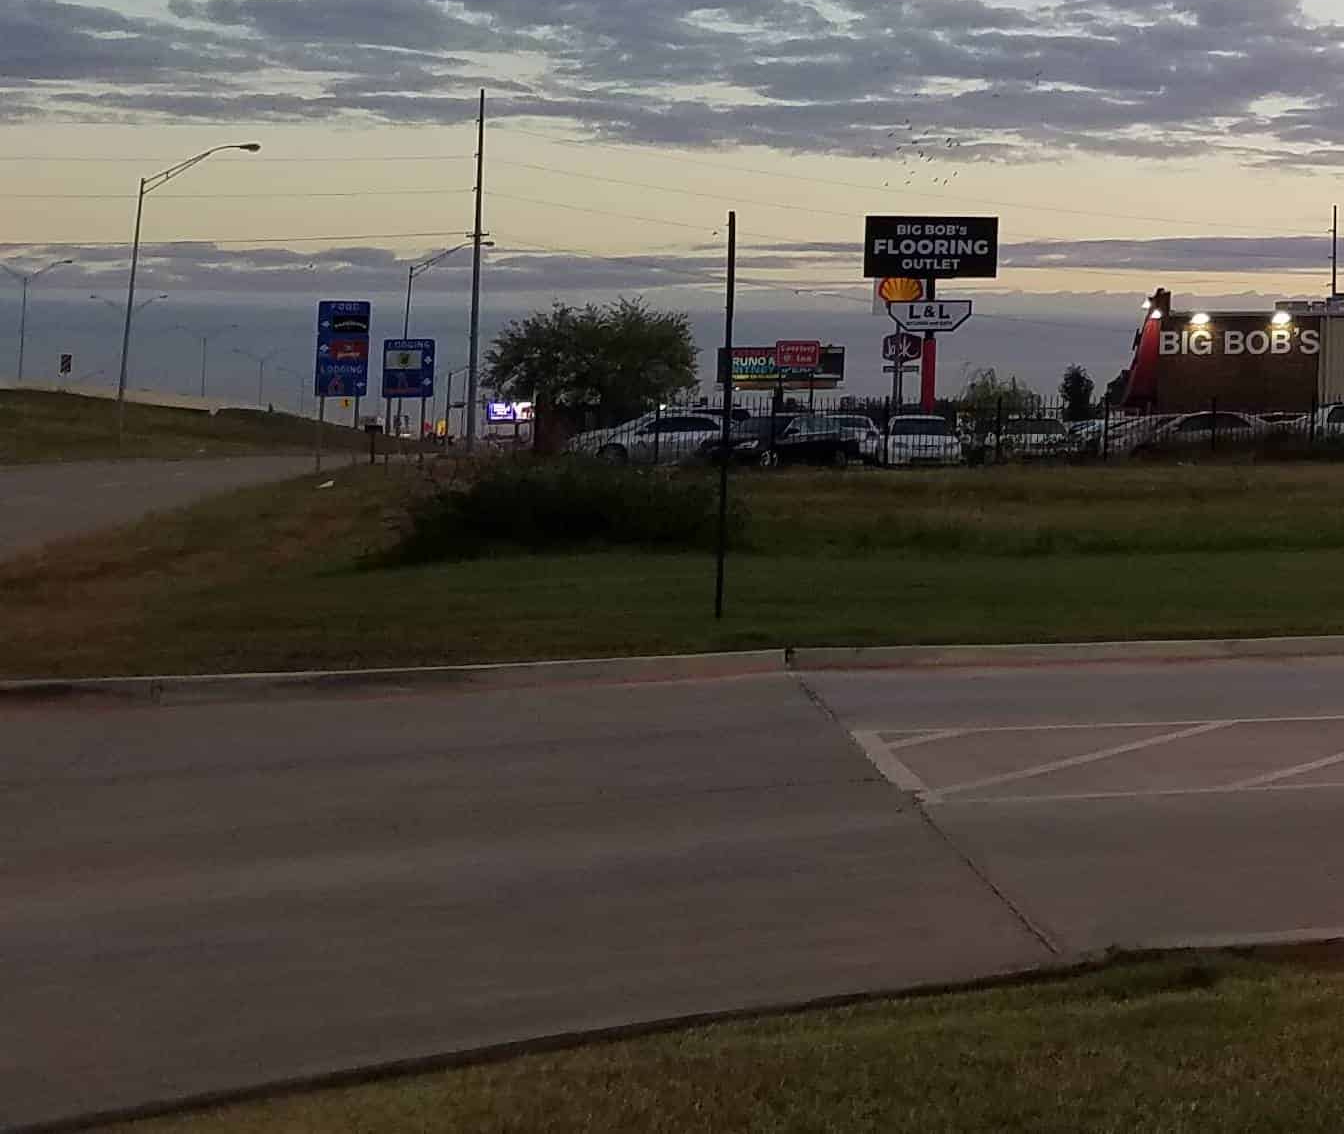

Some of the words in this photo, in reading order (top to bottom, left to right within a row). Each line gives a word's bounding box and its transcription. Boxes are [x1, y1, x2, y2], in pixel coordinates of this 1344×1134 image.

[896, 225, 922, 235] BIG
[873, 239, 989, 255] FLOORING
[901, 258, 961, 270] OUTLET
[388, 340, 432, 349] LODGING
[1159, 330, 1213, 355] BIG
[1223, 327, 1321, 355] BOB'S
[732, 356, 767, 366] RUNO
[320, 364, 363, 374] LODGING
